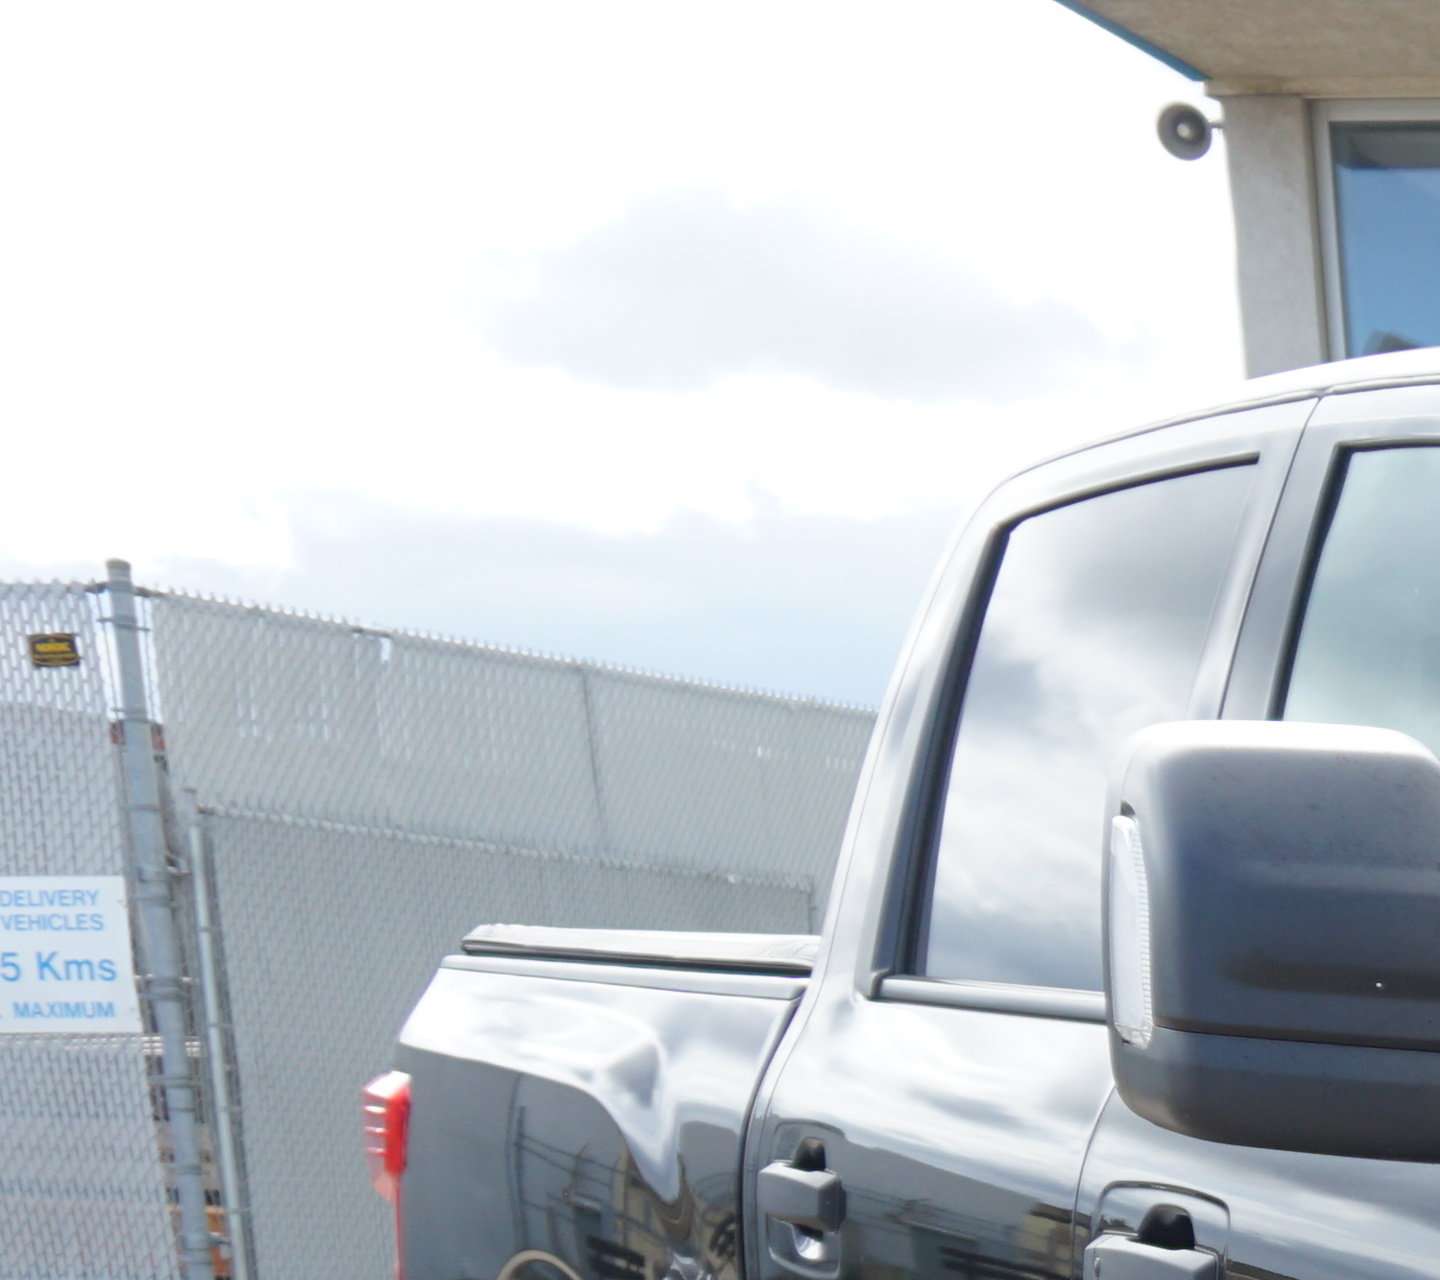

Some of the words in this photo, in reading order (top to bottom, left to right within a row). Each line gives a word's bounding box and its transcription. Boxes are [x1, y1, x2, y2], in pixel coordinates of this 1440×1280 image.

[0, 889, 99, 907] DELIVERY
[0, 913, 105, 931] VEHICLES
[36, 951, 118, 981] Kms
[12, 1001, 116, 1018] MAXIMUM
